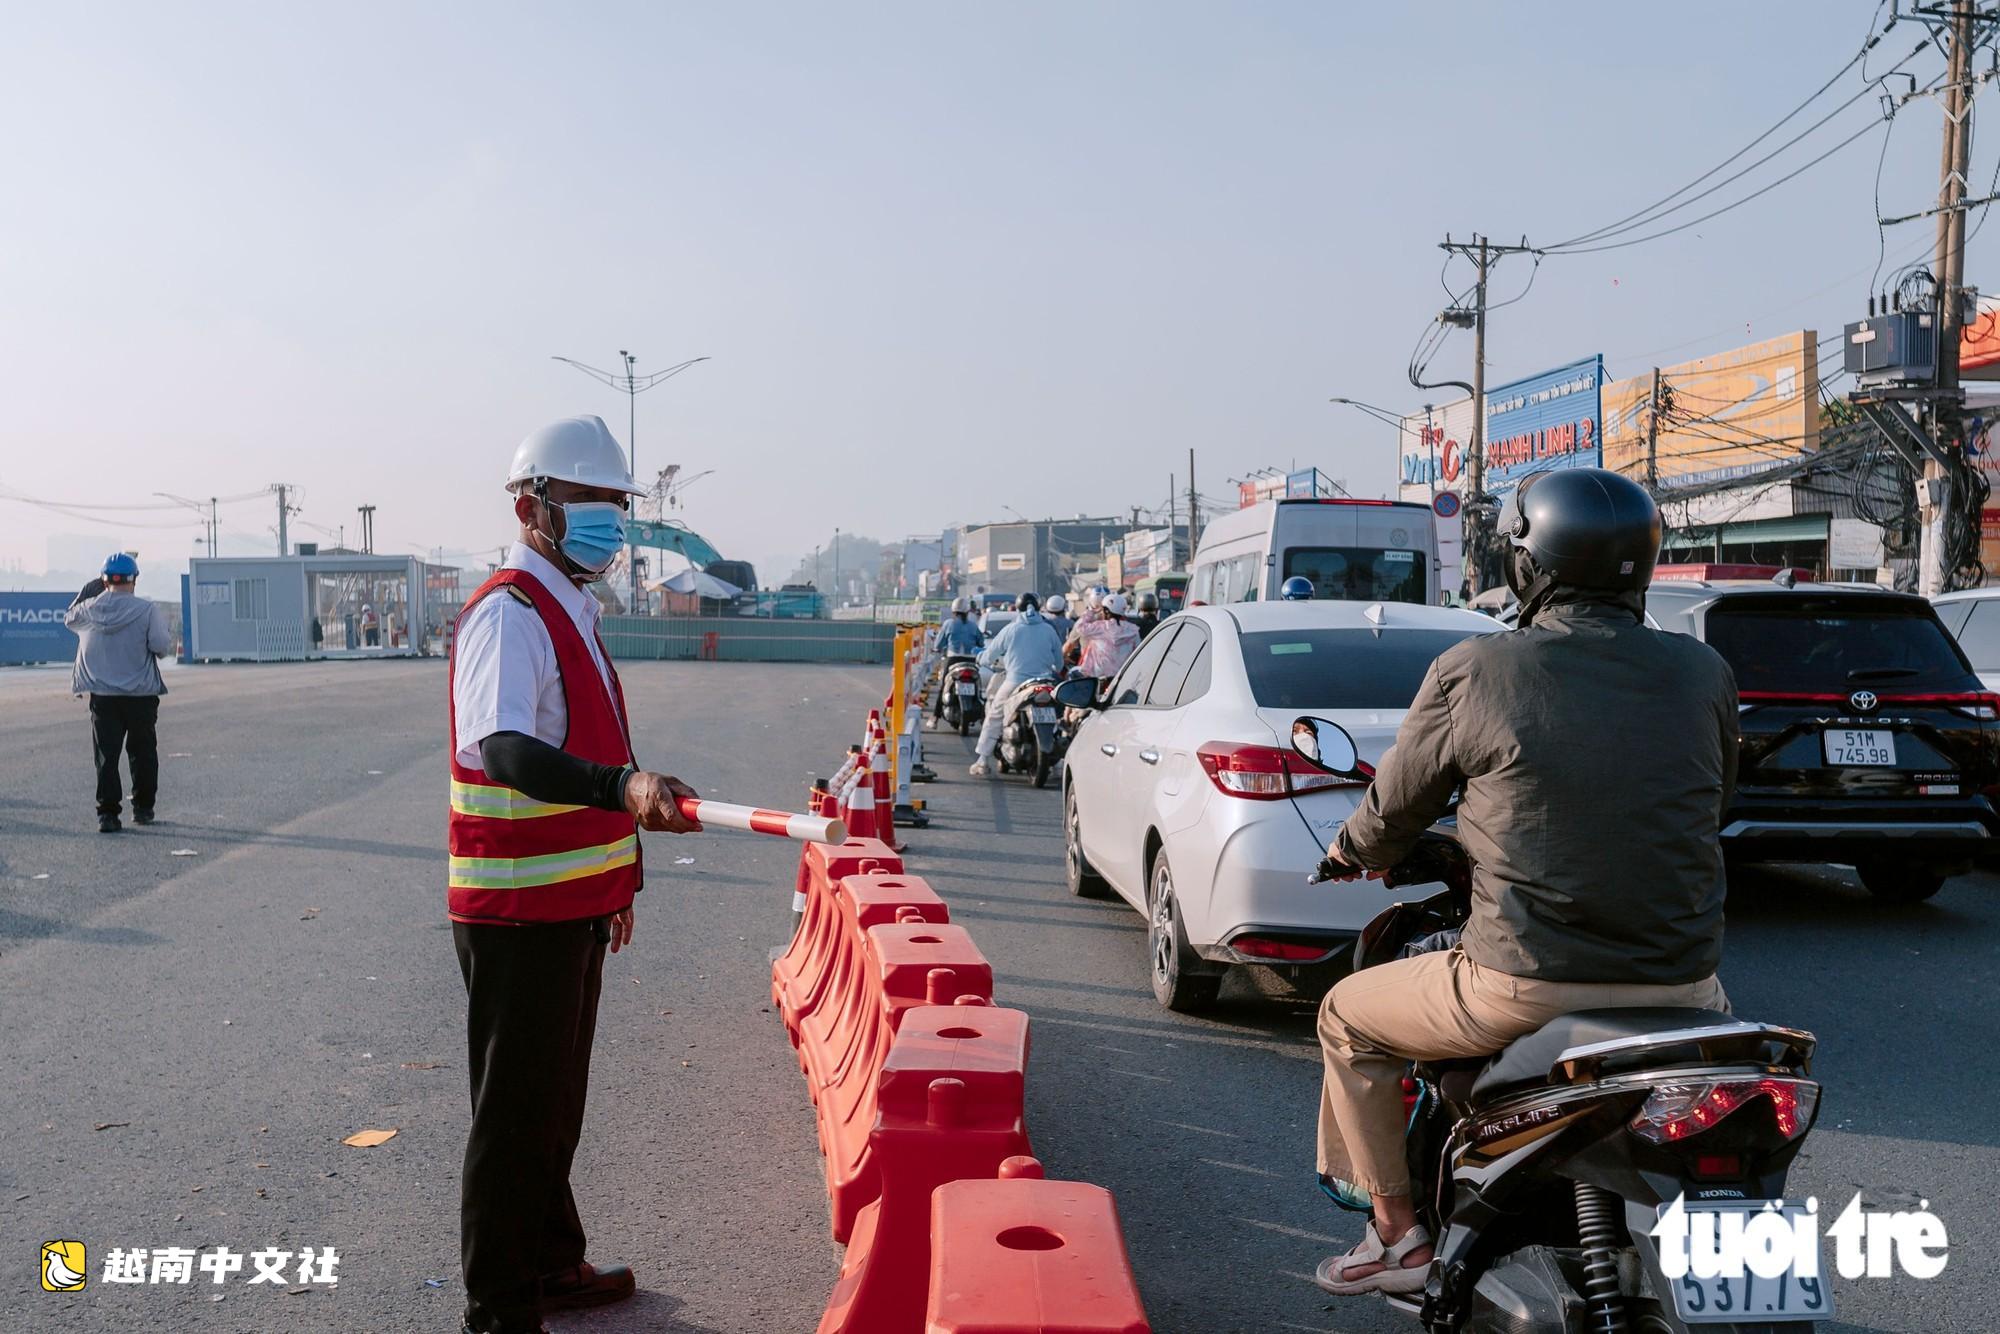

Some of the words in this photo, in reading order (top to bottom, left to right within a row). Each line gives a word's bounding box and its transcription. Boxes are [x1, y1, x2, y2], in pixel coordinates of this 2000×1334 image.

[1488, 432, 1532, 474] MẠNH
[1536, 422, 1575, 459] LINH
[1580, 416, 1593, 449] 2
[0, 608, 66, 623] THACO
[1845, 732, 1875, 747] 51M
[1835, 748, 1889, 763] 745.98
[1699, 1189, 1745, 1198] HONDA
